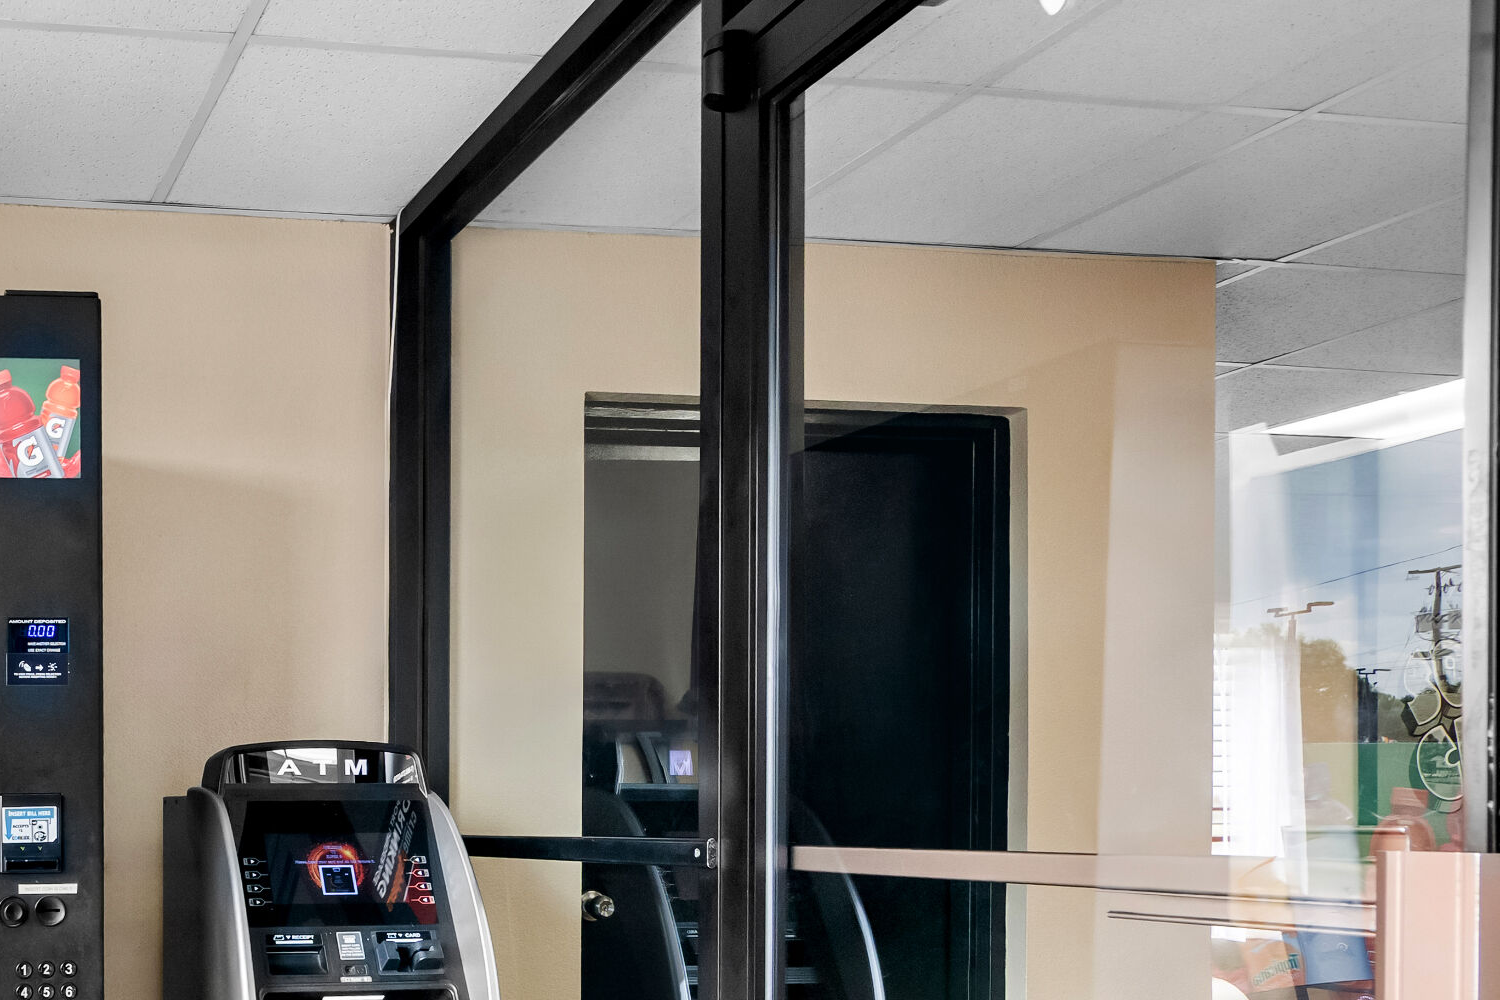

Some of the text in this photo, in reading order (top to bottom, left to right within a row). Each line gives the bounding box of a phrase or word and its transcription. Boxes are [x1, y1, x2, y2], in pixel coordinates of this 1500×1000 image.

[28, 625, 55, 637] 0.00
[277, 759, 368, 775] ATM
[21, 965, 26, 975] 1
[43, 964, 50, 974] 2
[65, 963, 72, 974] 3
[21, 987, 28, 998] 4
[43, 987, 50, 997] 5
[66, 986, 73, 997] 6
